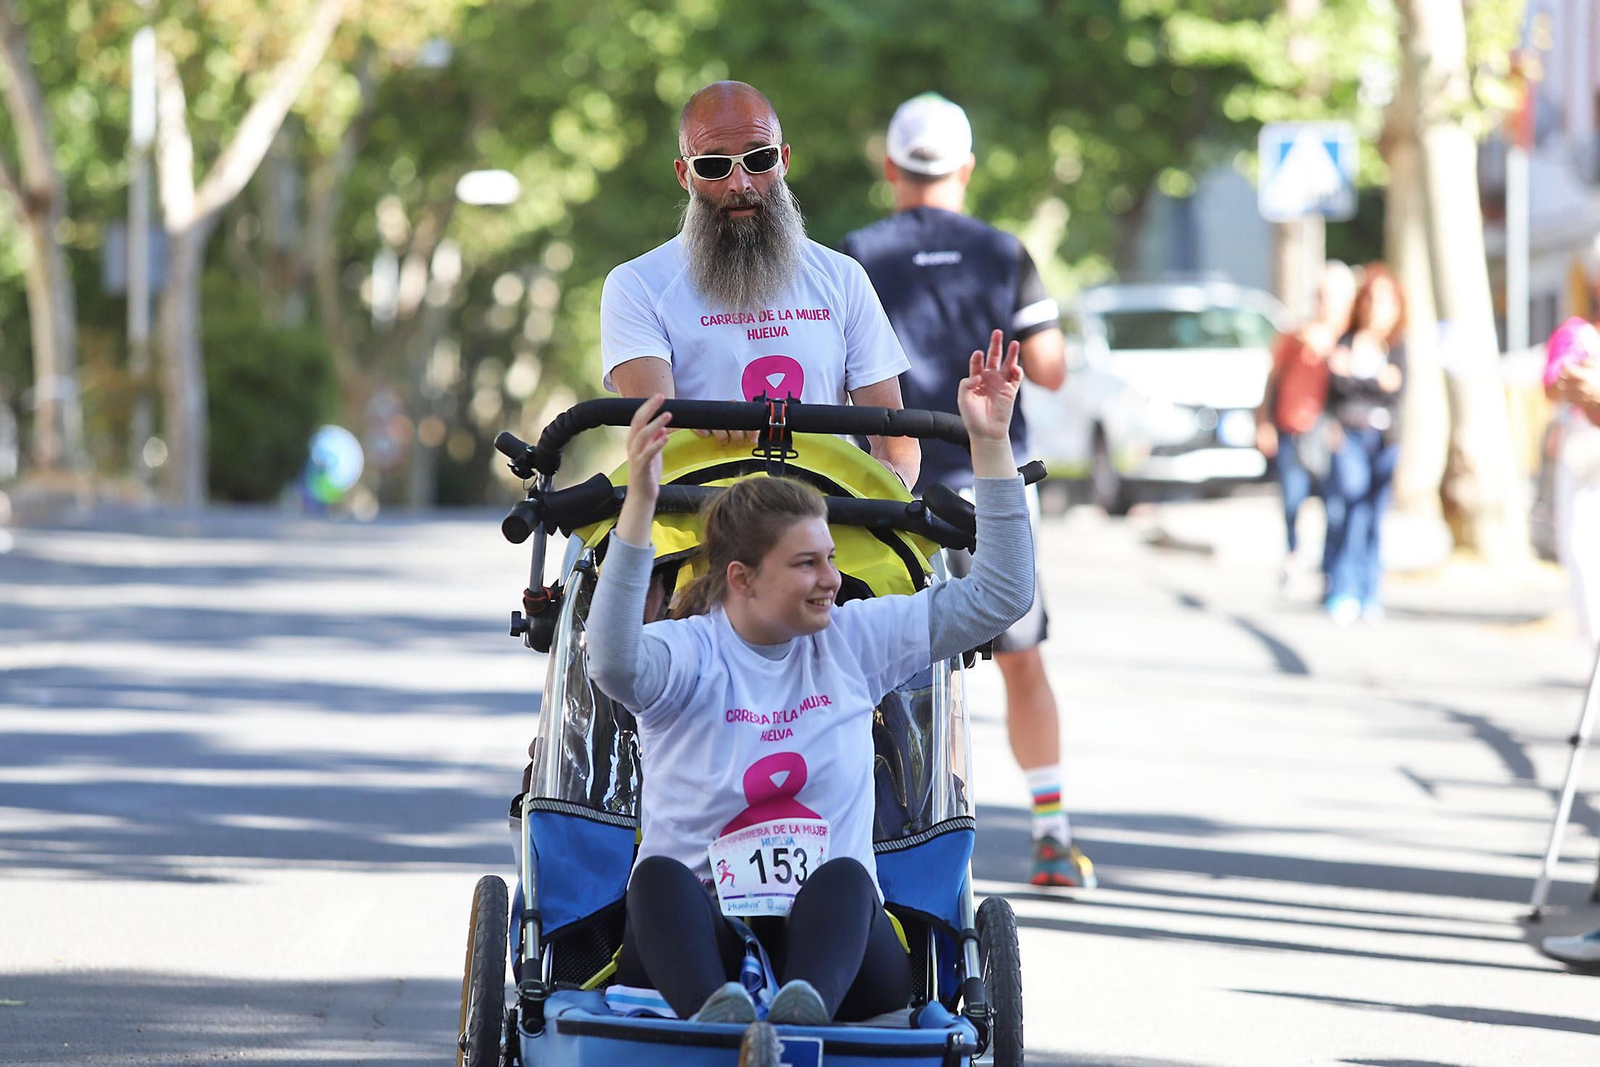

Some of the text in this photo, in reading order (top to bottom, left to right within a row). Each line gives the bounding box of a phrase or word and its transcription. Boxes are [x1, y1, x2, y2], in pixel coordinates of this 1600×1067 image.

[700, 308, 831, 327] CARRERA DE LA MUJER
[747, 326, 789, 341] HUELVA
[725, 709, 770, 725] CRRERA
[783, 709, 798, 723] LA
[799, 695, 832, 714] MUJR
[772, 824, 787, 835] DE
[788, 824, 801, 834] LA
[802, 824, 828, 837] MUJER
[749, 847, 808, 887] 153
